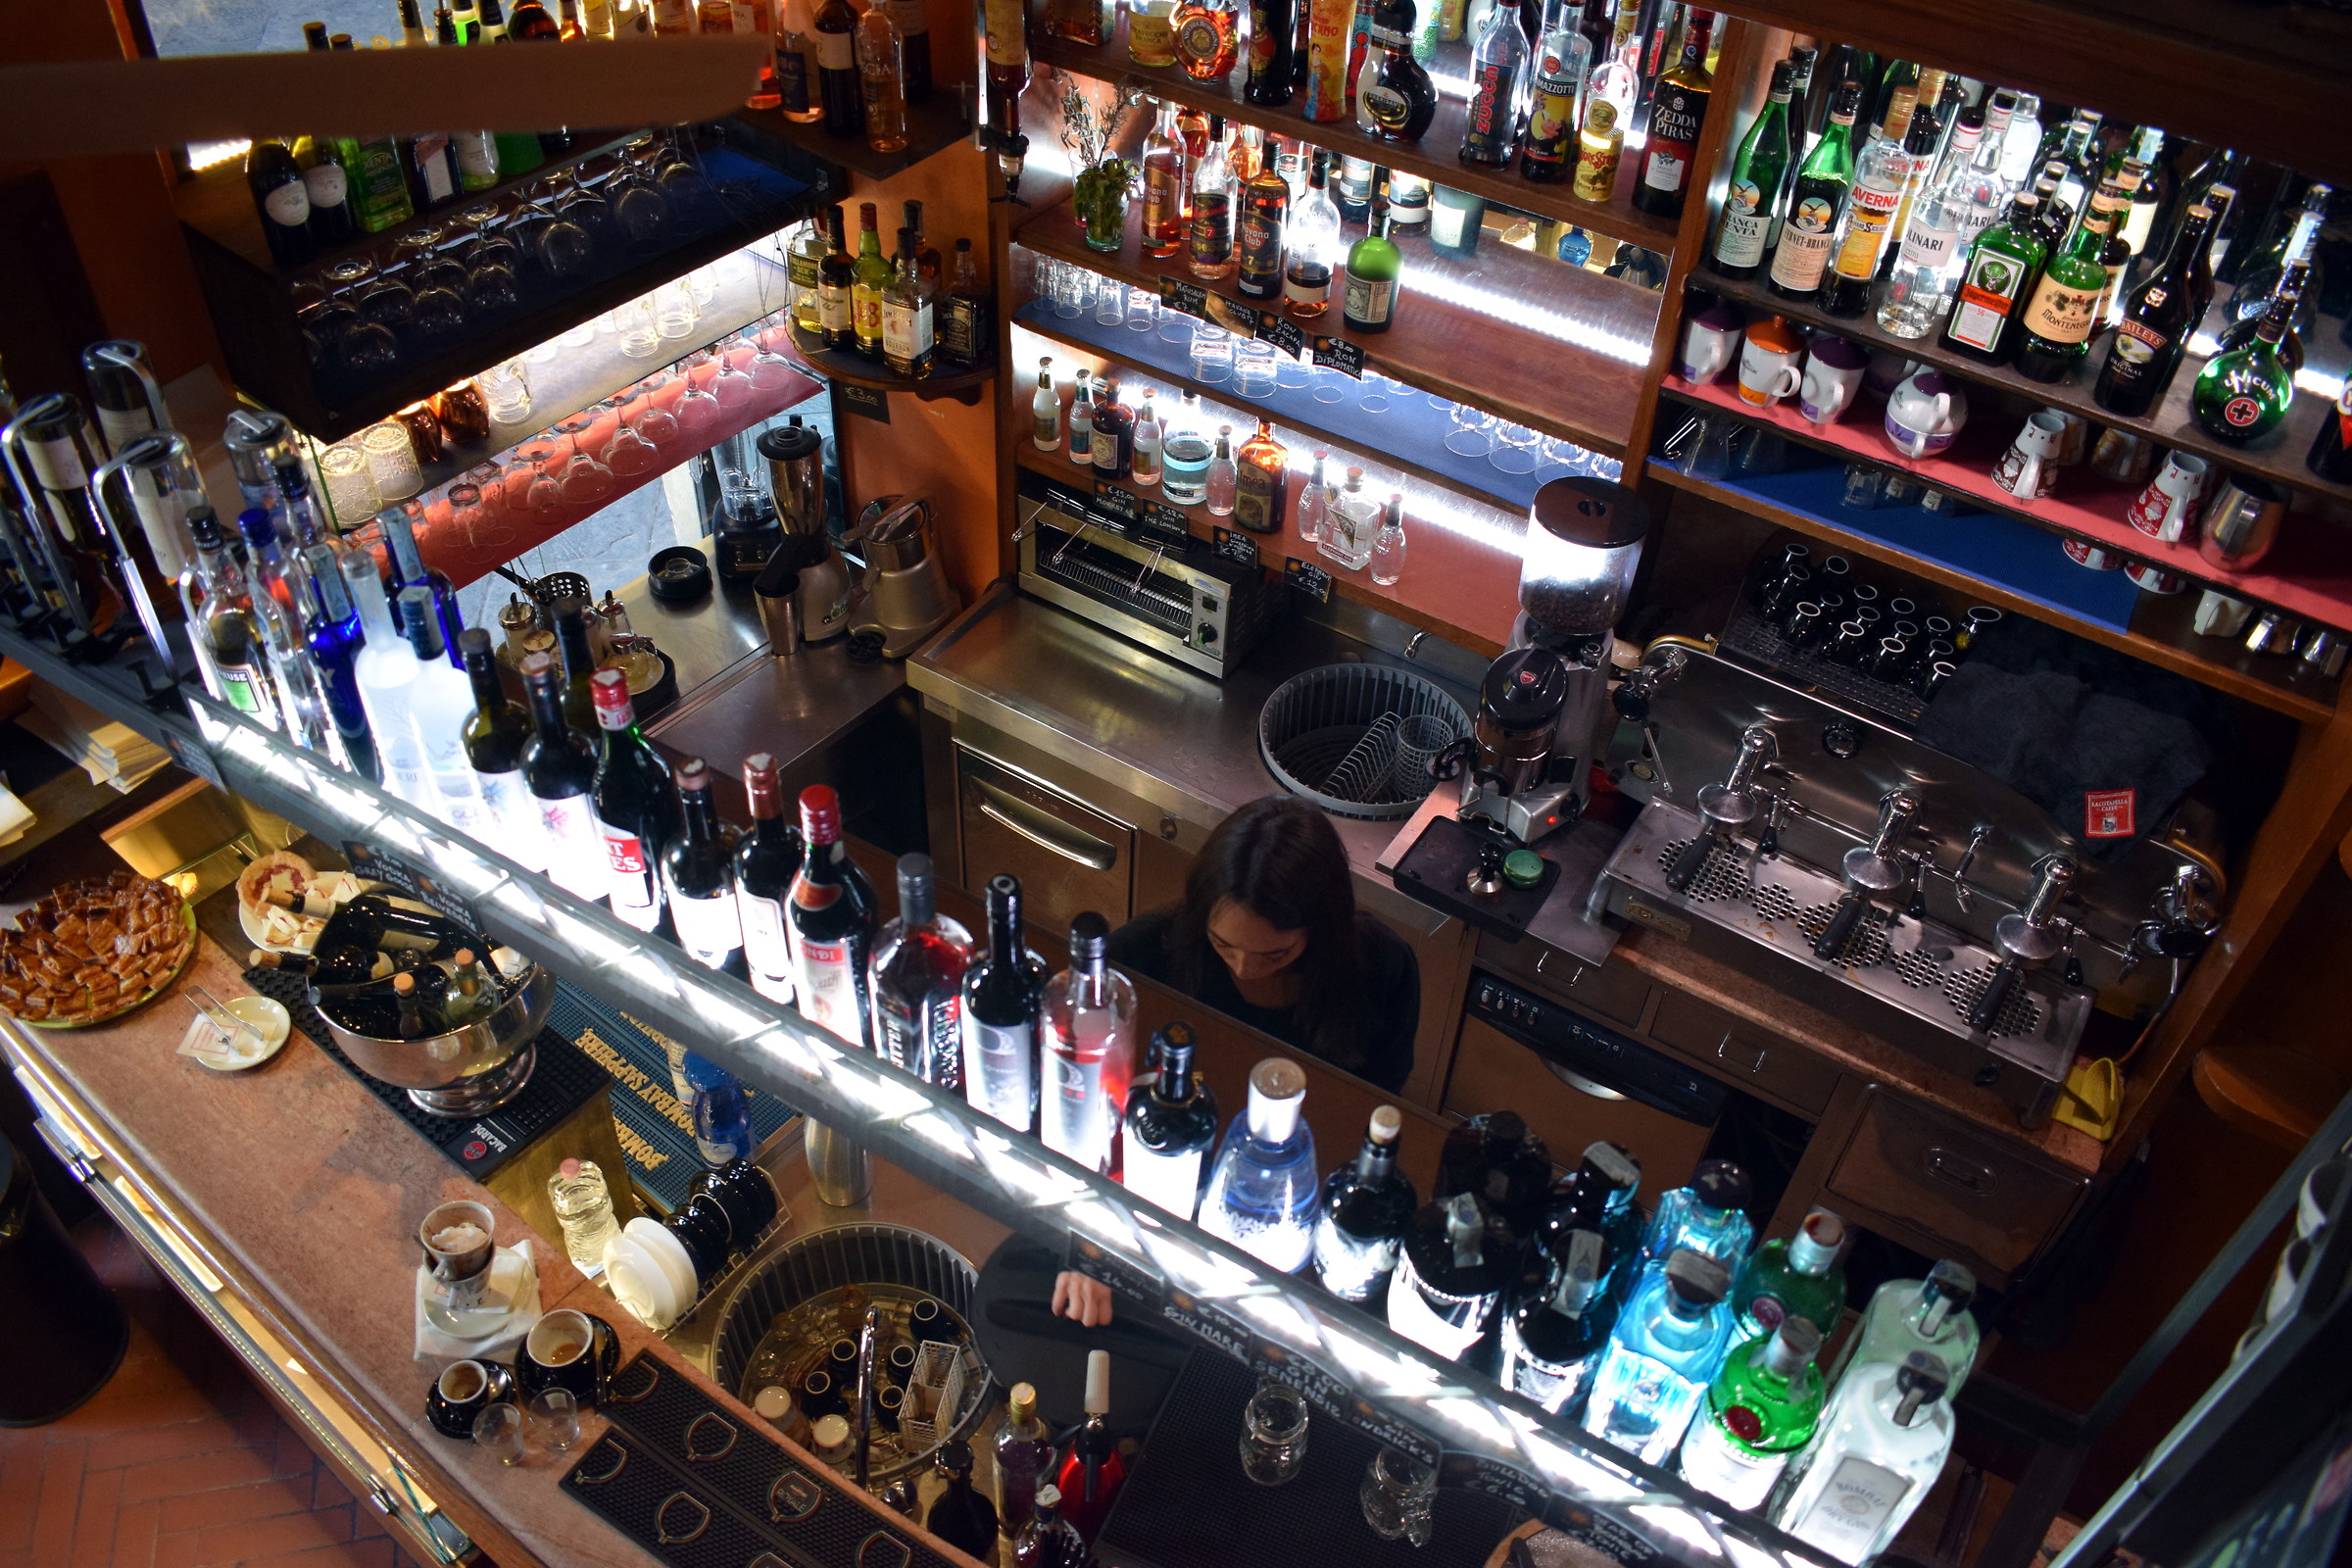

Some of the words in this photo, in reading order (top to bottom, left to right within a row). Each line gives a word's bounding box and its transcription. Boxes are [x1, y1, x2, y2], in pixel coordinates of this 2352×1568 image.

[1476, 66, 1499, 135] ZUCCA
[1654, 104, 1697, 129] ZEDDA
[1654, 119, 1693, 141] PIRAS
[1851, 185, 1899, 209] AVERNA
[1244, 234, 1261, 247] Club
[854, 297, 881, 328] J&B
[1225, 299, 1251, 315] HAVANA
[1275, 325, 1300, 347] ZACAPA
[1277, 317, 1298, 333] RON
[2120, 320, 2164, 348] BAILEYS
[1334, 348, 1357, 364] RON
[2109, 357, 2143, 378] ORIGINAL
[2224, 368, 2277, 401] UNICUM
[1096, 496, 1124, 513] MONKEY
[1322, 543, 1344, 558] ELEPHANT
[1300, 562, 1332, 581] ELEPHANT
[354, 864, 385, 882] GREY
[573, 1027, 651, 1092] SAPPHIRE
[1161, 1305, 1198, 1330] GIN
[1200, 1321, 1247, 1357] MARE
[1285, 1364, 1328, 1396] GIN
[1476, 1470, 1527, 1496] TONIC
